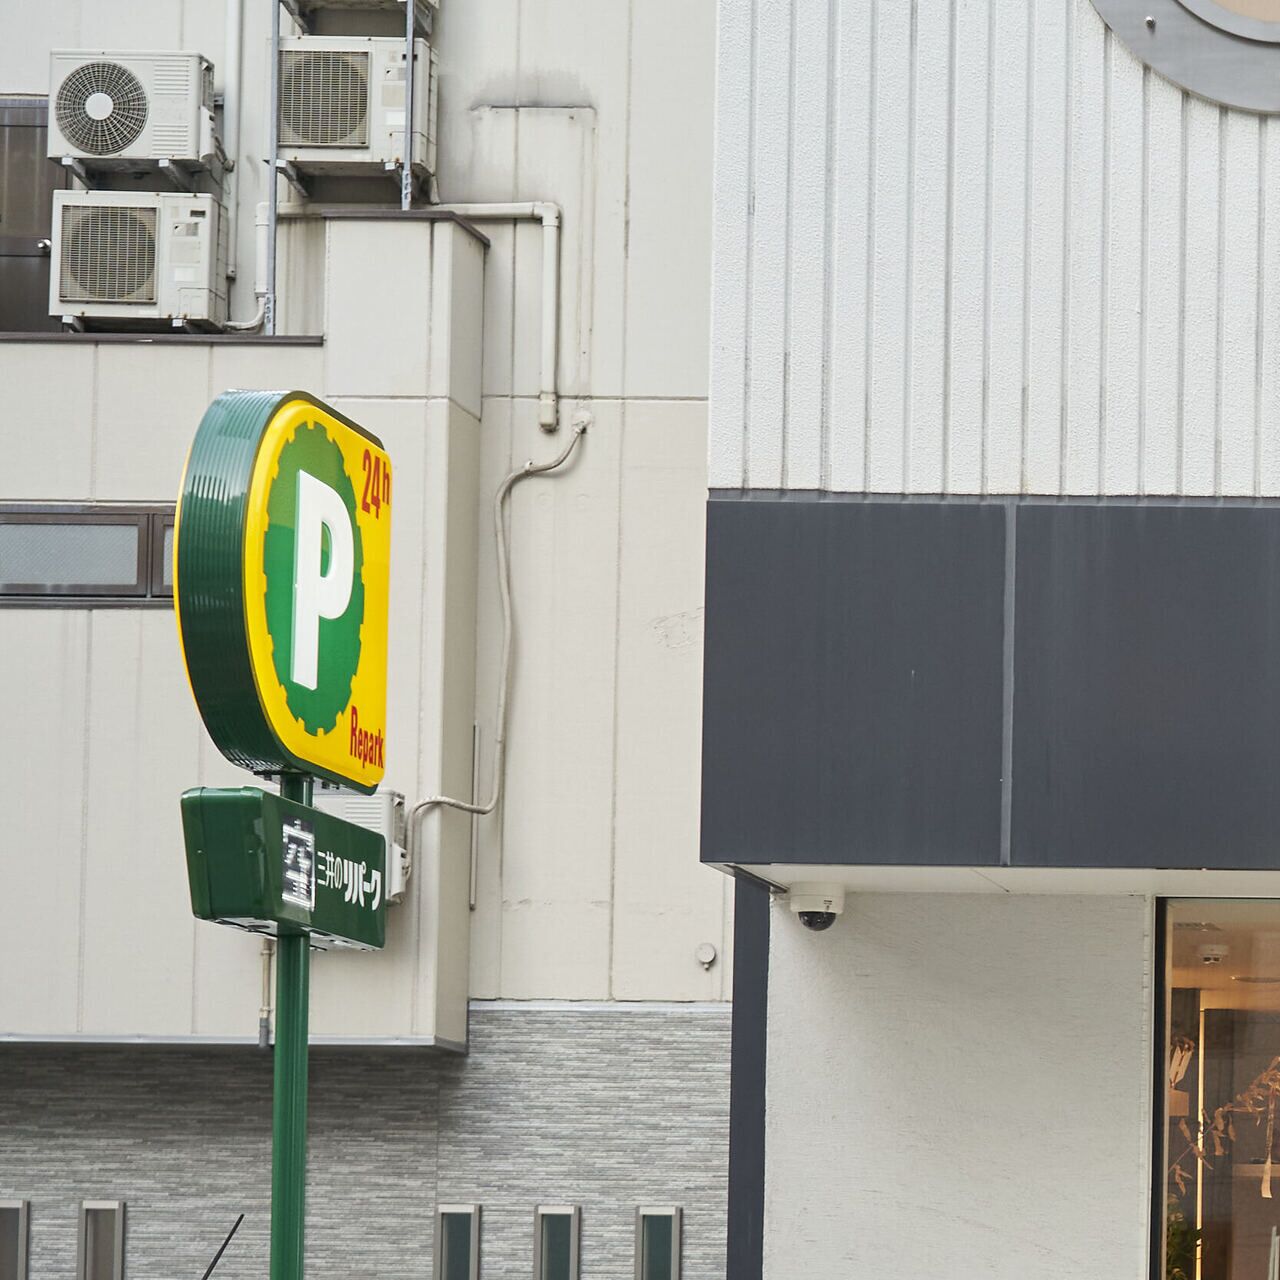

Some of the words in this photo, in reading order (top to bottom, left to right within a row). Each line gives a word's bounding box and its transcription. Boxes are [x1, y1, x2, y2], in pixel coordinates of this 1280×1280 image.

[362, 448, 390, 520] 24h
[291, 469, 354, 691] P
[350, 705, 384, 769] Repark
[317, 851, 381, 911] 三井のリパーク
